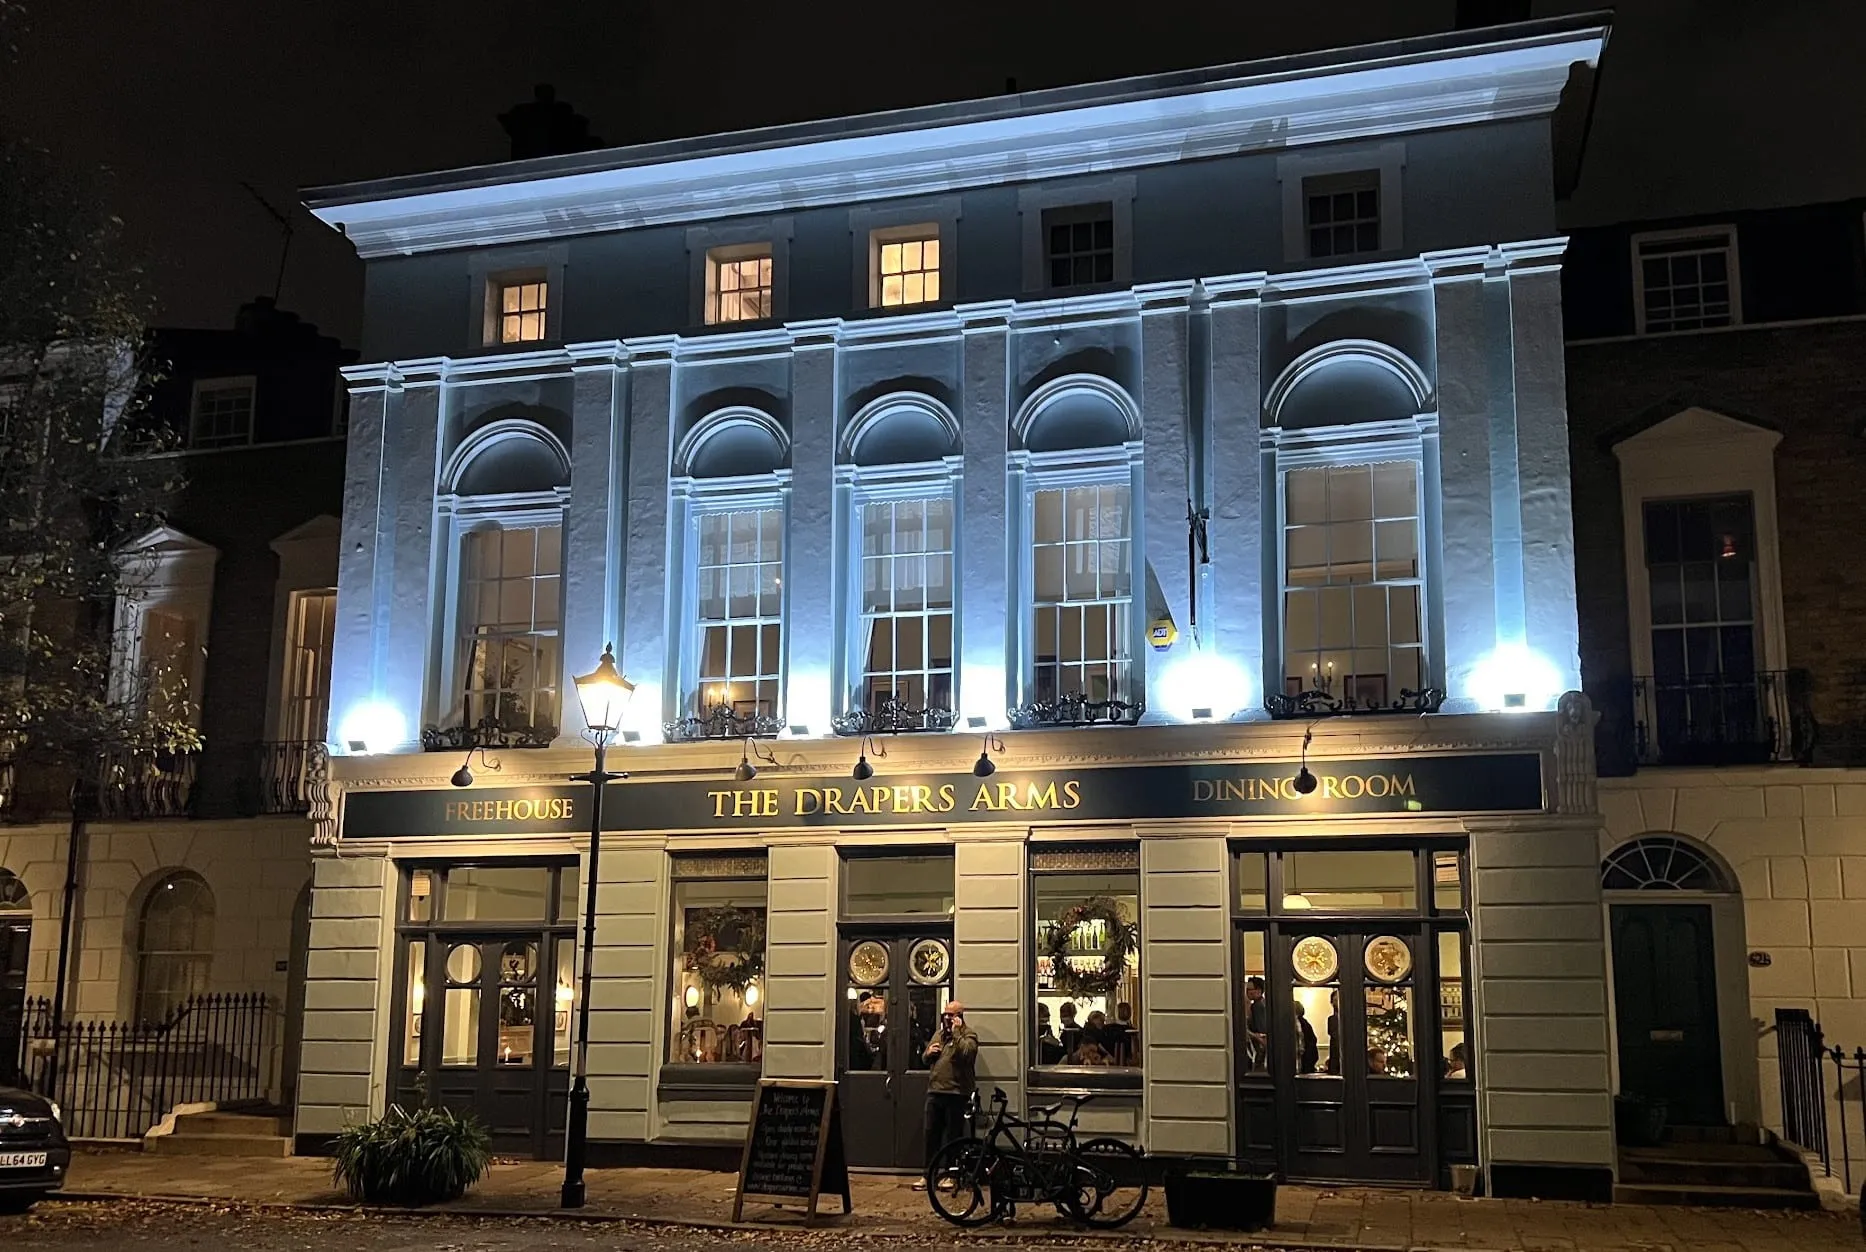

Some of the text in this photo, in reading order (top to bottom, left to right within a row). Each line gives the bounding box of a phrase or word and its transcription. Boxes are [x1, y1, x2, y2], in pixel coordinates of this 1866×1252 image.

[1153, 629, 1166, 637] ADT
[1323, 774, 1416, 799] ROOM
[445, 798, 574, 822] FREEHOUSE
[707, 779, 1082, 819] THE DRAPERS ARMS
